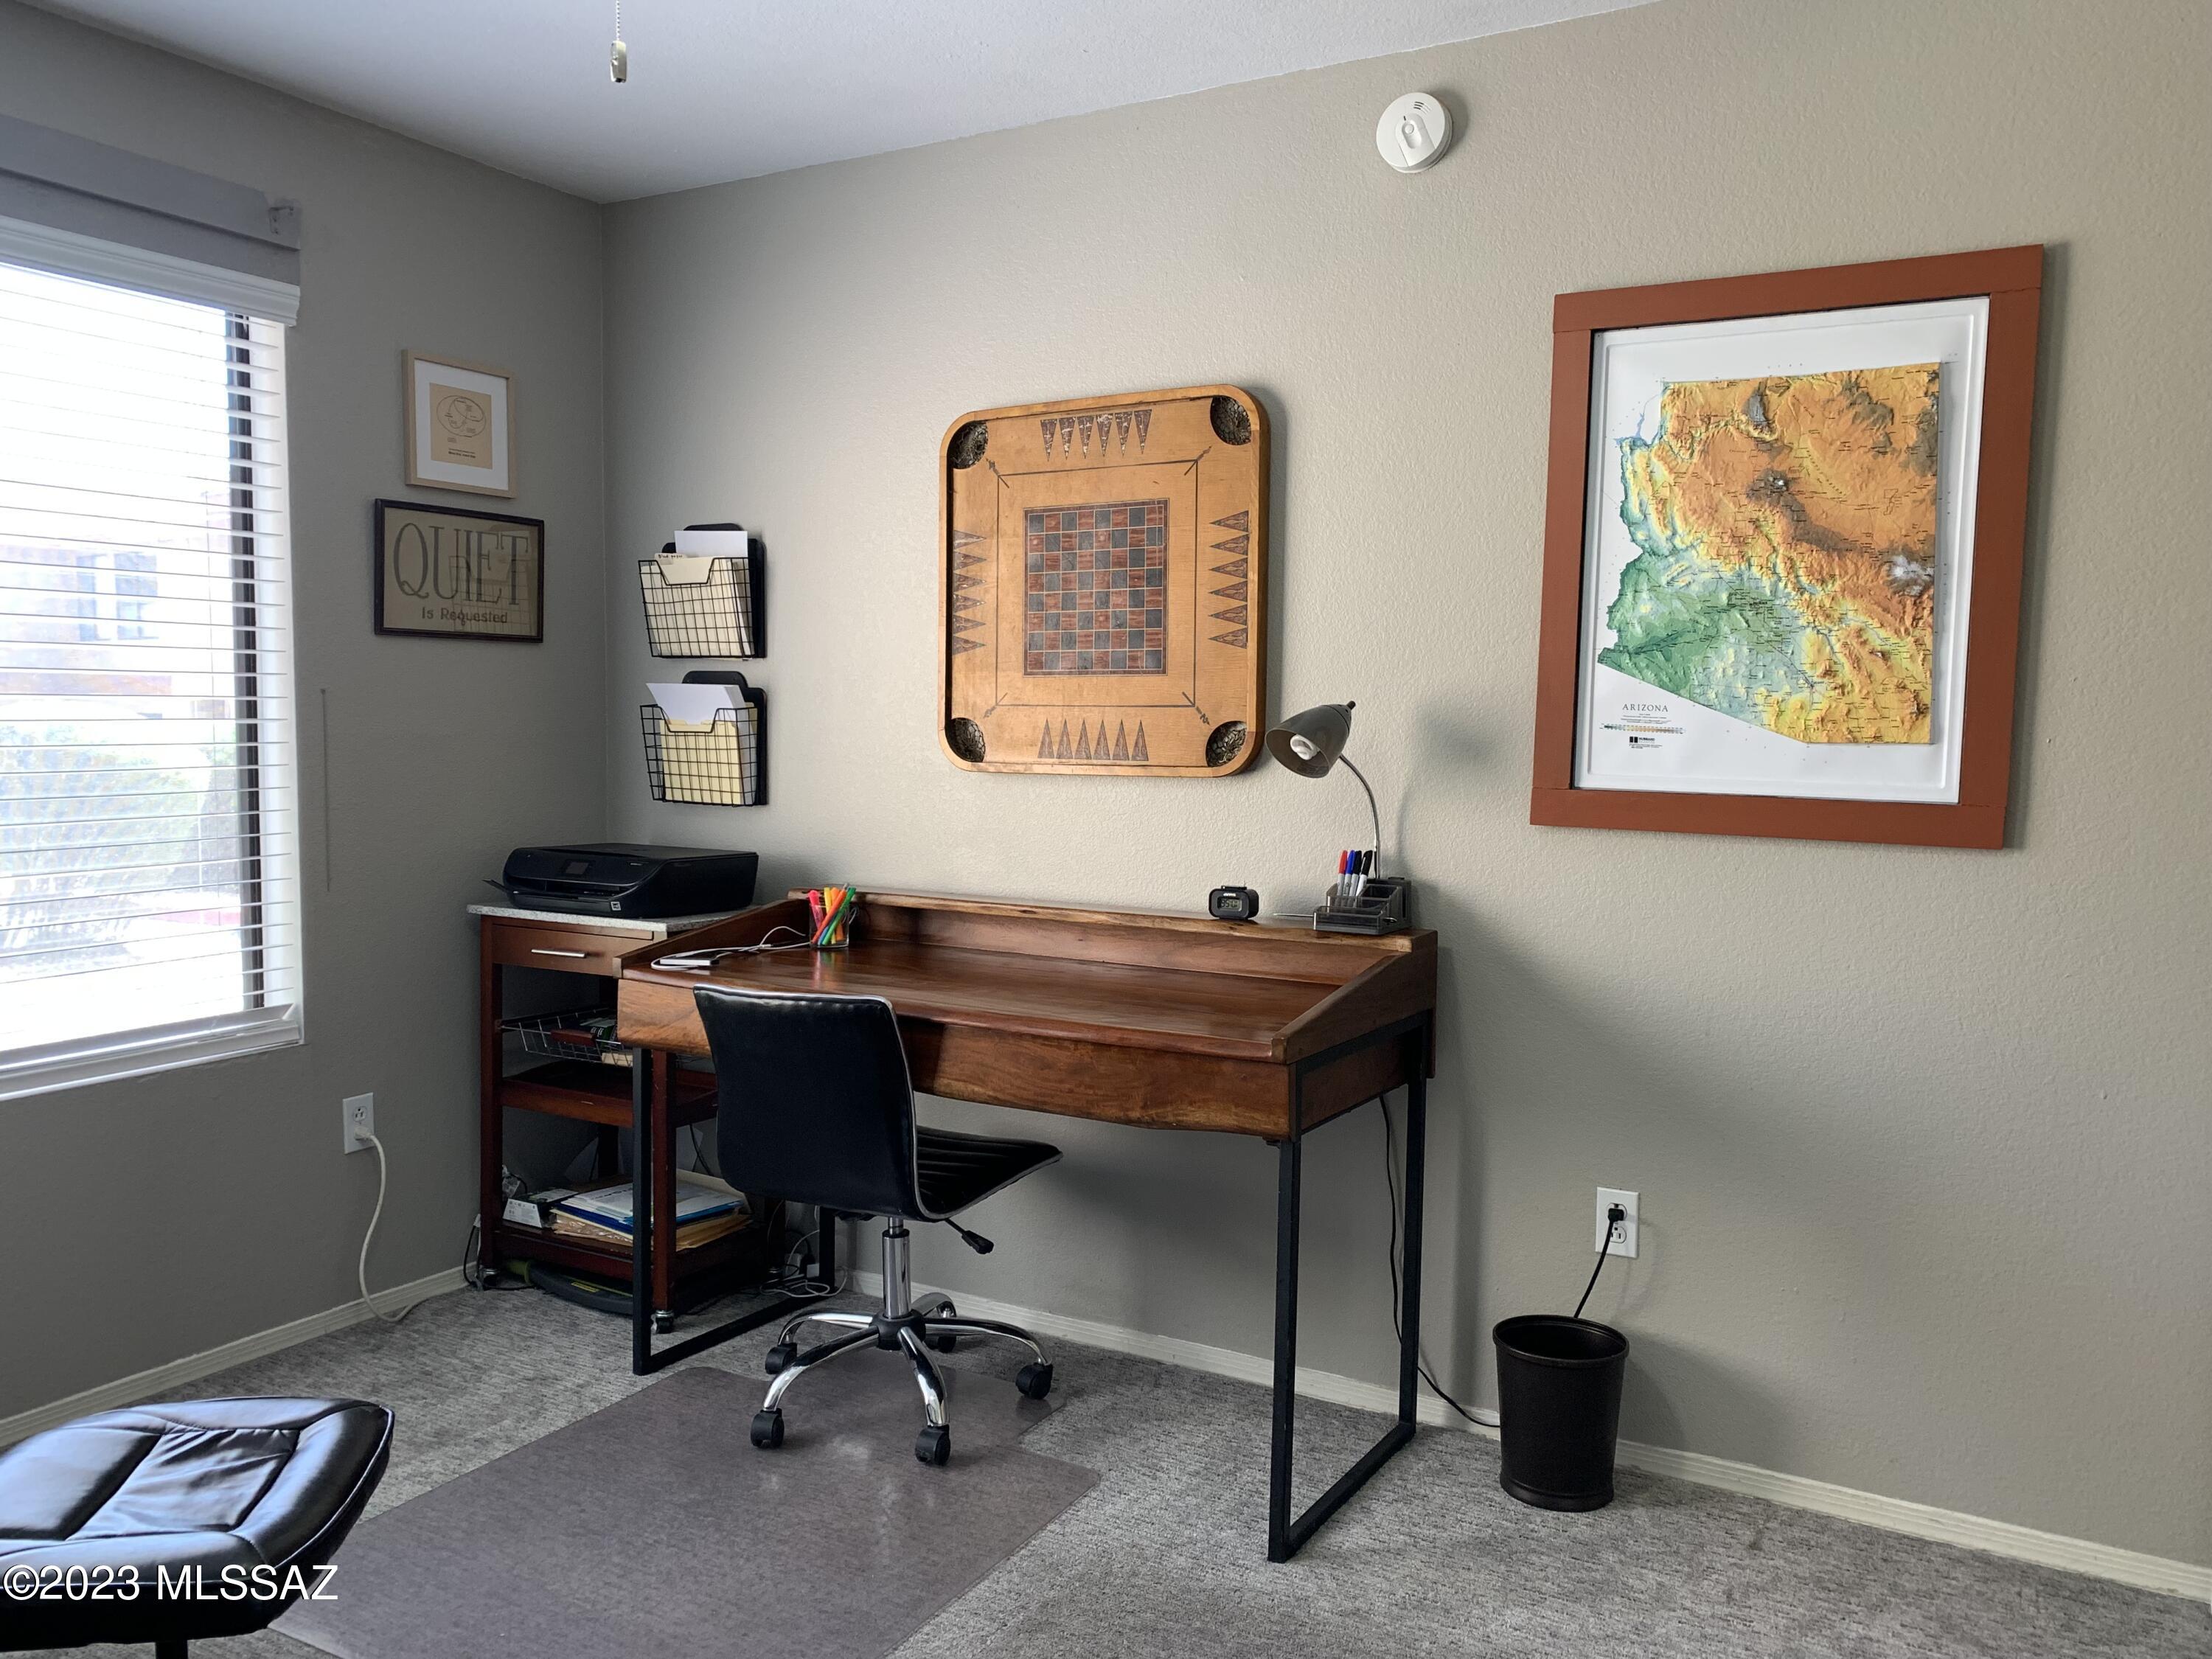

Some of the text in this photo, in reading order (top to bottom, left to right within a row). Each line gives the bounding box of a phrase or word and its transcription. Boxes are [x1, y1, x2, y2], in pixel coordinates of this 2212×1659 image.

[394, 522, 529, 605] QUIET
[422, 607, 508, 625] Is Requested
[1622, 703, 1669, 712] ARIZONA
